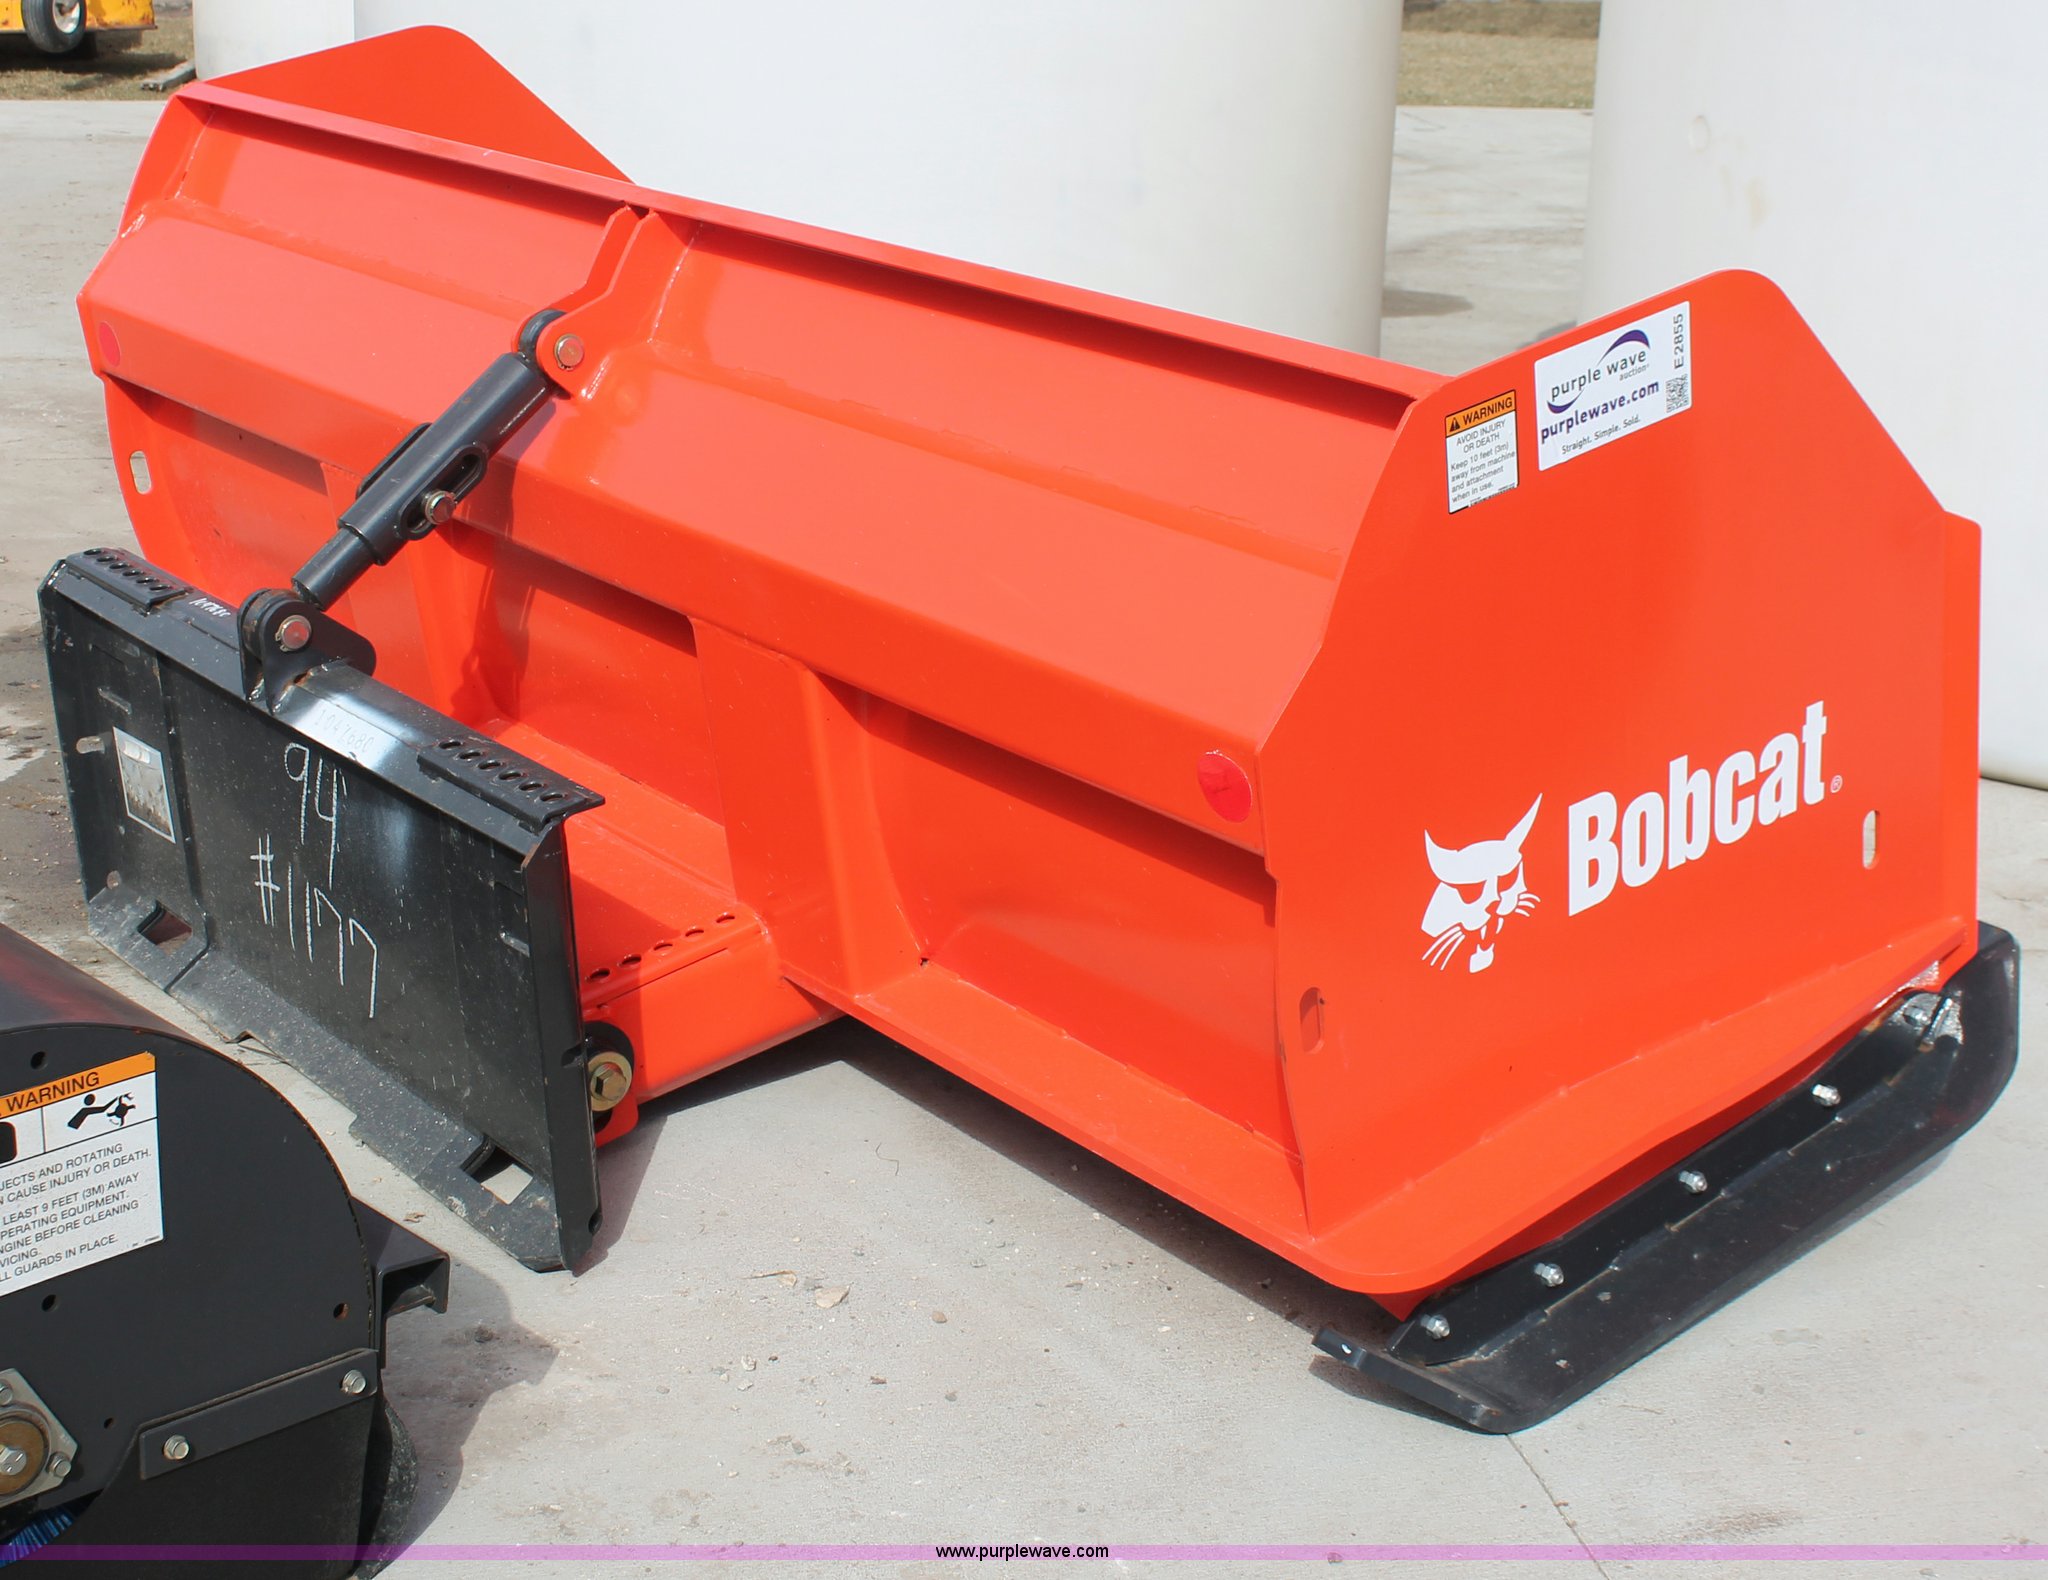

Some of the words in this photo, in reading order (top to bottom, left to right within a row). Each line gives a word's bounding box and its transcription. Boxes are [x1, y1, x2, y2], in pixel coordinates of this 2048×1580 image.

[1551, 367, 1601, 402] purple
[1606, 350, 1647, 376] wave
[1462, 396, 1513, 426] WARNING
[1541, 381, 1660, 444] purplewave.com
[1457, 430, 1479, 446] AVOID
[1480, 418, 1506, 436] INJURY
[1463, 442, 1475, 453] OR
[1475, 431, 1500, 449] DEATH
[1562, 435, 1592, 455] Straight.
[1594, 424, 1621, 440] Simple.
[1623, 414, 1641, 428] Sold.
[1451, 460, 1469, 471] Keep
[1470, 454, 1479, 463] 10
[1479, 448, 1493, 460] feet
[1494, 441, 1509, 455] (3m)
[1451, 470, 1469, 482] away
[1470, 462, 1486, 474] from
[1487, 451, 1516, 467] machine
[1451, 480, 1465, 493] and
[1466, 465, 1504, 487] attachment
[1452, 491, 1470, 503] when
[1471, 487, 1479, 495] in
[1568, 700, 1828, 917] Bobcat
[250, 833, 378, 1019] #1177
[6, 1071, 100, 1112] WARNING
[7, 1181, 48, 1203] CAUSE
[49, 1167, 92, 1189] INJURY
[93, 1161, 111, 1175] OR
[113, 1148, 152, 1169] DEATH.
[38, 1163, 63, 1180] AND
[66, 1143, 123, 1169] ROTATING
[0, 1213, 58, 1240] PERATING
[61, 1189, 130, 1220] EQUIPMENT.
[3, 1205, 39, 1226] LEAST
[42, 1202, 49, 1213] 9
[52, 1192, 79, 1210] FEET
[82, 1184, 105, 1201] (3M)
[107, 1171, 139, 1191] AWAY
[35, 1218, 81, 1242] BEFORE
[83, 1199, 139, 1226] CLEANING
[14, 1252, 63, 1277] GUARDS
[65, 1247, 77, 1259] IN
[79, 1233, 118, 1254] PLACE.
